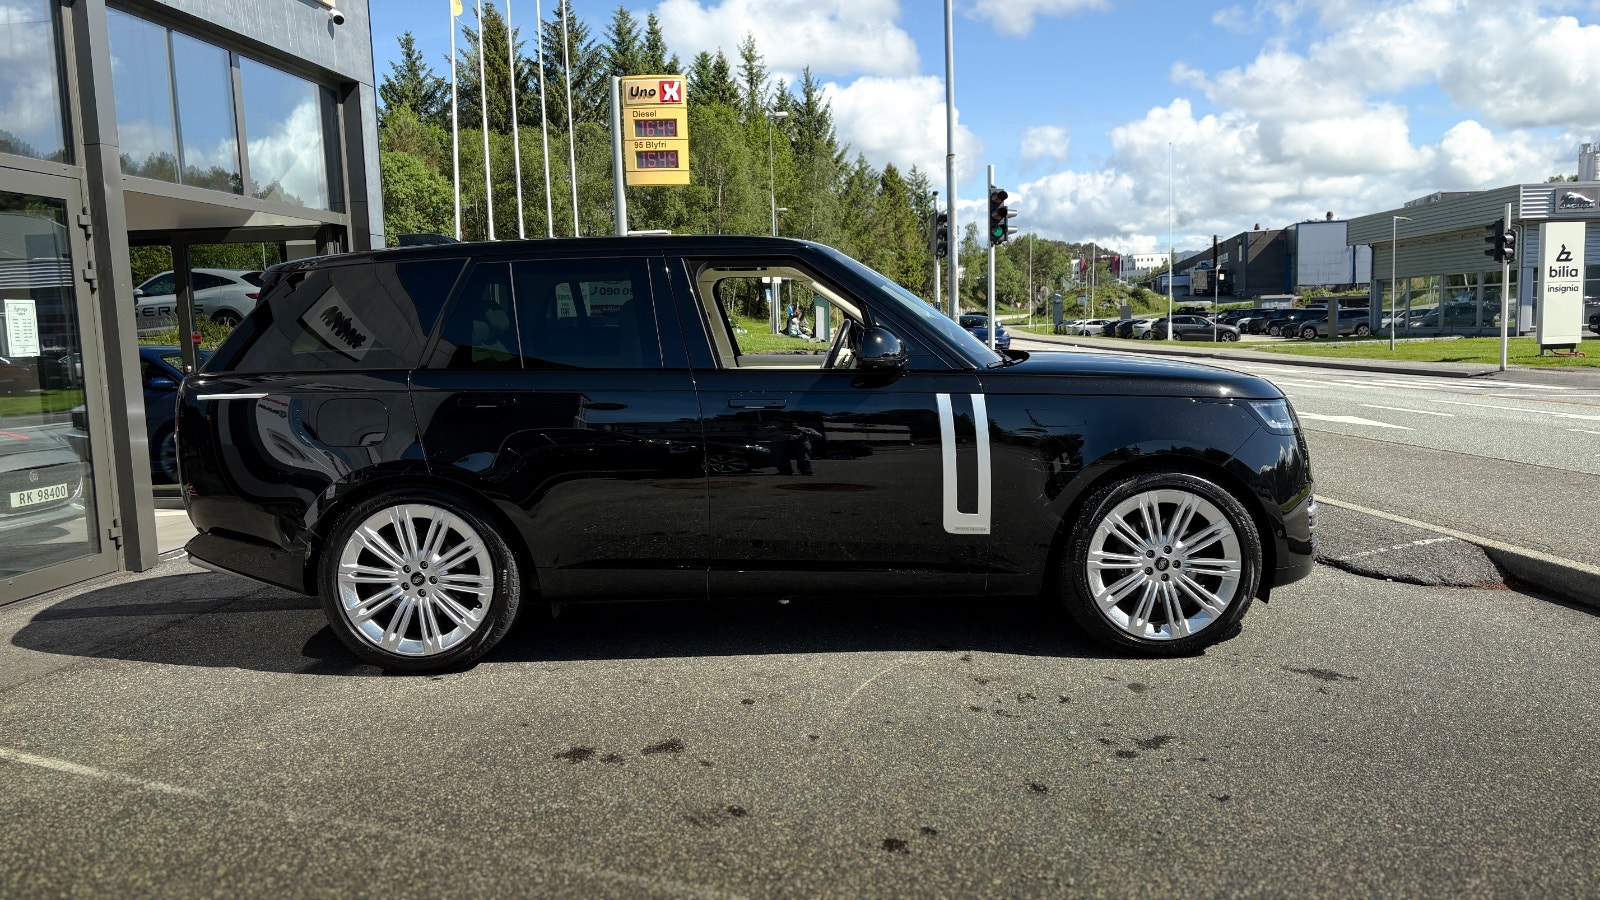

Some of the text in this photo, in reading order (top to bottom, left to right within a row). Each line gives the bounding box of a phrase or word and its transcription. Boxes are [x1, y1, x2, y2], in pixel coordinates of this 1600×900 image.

[630, 82, 680, 100] Uno X
[646, 141, 666, 149] Blyfri
[1549, 266, 1578, 278] bilia
[1548, 284, 1579, 294] insignia
[20, 486, 66, 504] RK 98400
